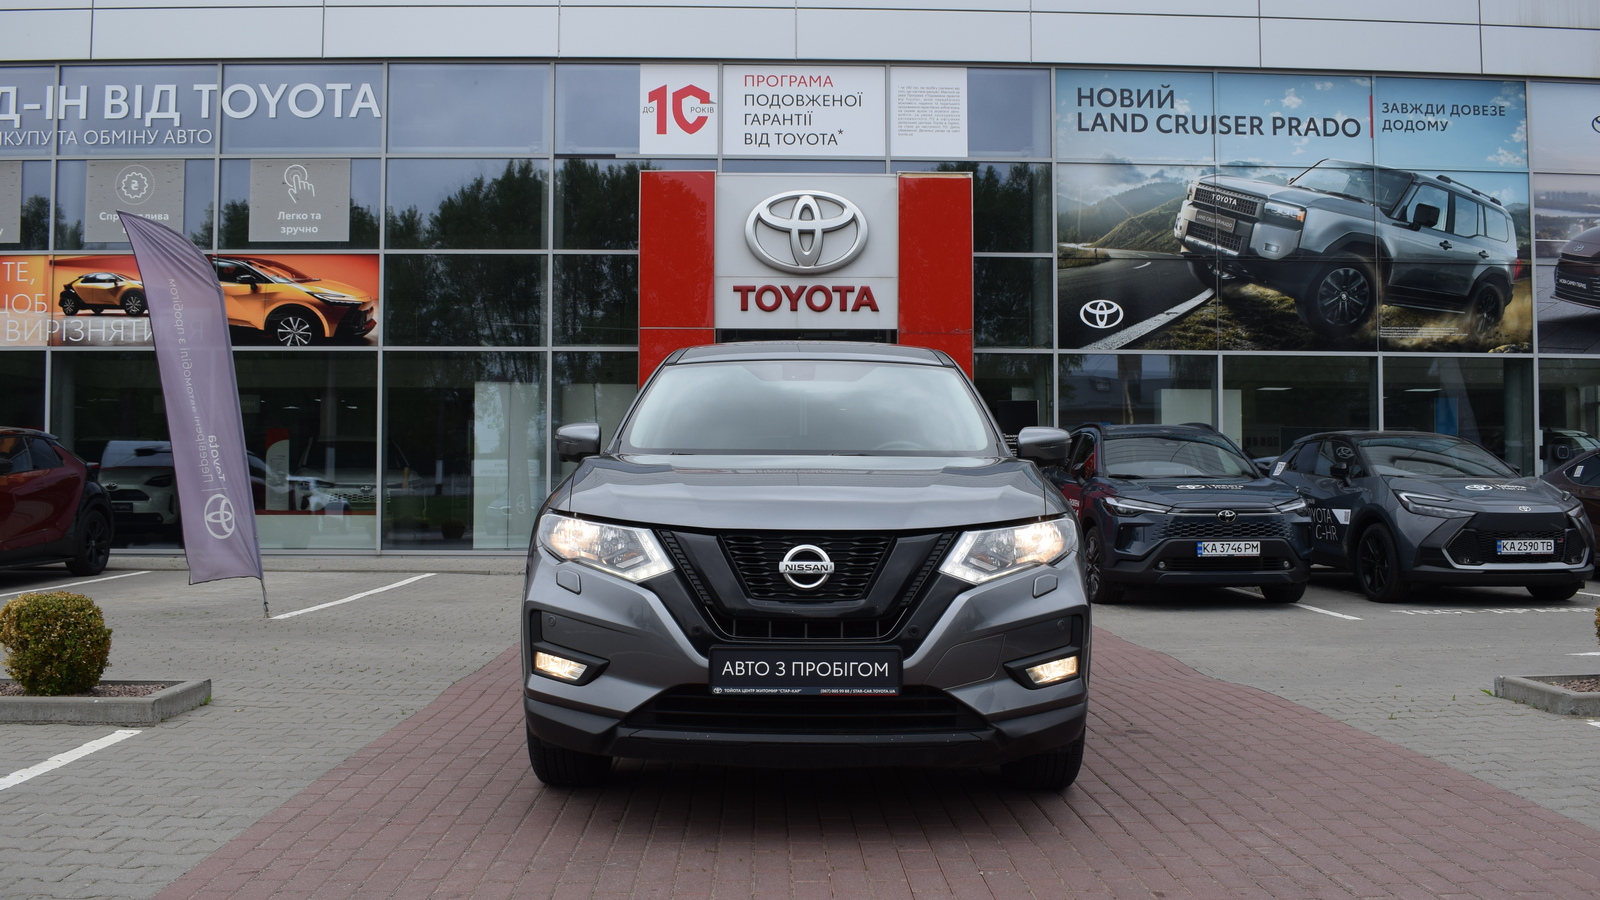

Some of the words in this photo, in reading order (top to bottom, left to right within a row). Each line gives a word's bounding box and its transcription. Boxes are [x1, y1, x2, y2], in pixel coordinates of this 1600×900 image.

[744, 75, 834, 87] ПРОГРАМА
[744, 92, 863, 109] ПОДОВЖЕНОЇ
[1077, 84, 1175, 109] НОВИЙ
[104, 84, 181, 127] ВІД
[193, 83, 382, 119] TOYOTA
[642, 106, 655, 114] ДО
[1381, 102, 1446, 116] ЗАВЖДИ
[1450, 104, 1507, 118] ДОВЕЗЕ
[744, 111, 813, 126] ГАРАНТІЇ
[1077, 112, 1149, 133] LAND
[1155, 114, 1265, 135] CRUISER
[1272, 116, 1362, 138] PRADO
[1381, 119, 1449, 134] ДОДОМУ
[0, 130, 52, 146] КУПУ
[58, 130, 78, 145] ТА
[83, 129, 159, 145] ОБМІНУ
[163, 129, 213, 145] АВТО
[744, 133, 771, 147] ВІД
[1211, 193, 1237, 206] TOYOTA
[277, 211, 308, 220] Легко
[311, 212, 322, 220] та
[280, 226, 319, 235] зручно
[733, 284, 880, 312] TOYOTA
[1315, 524, 1338, 540] C-HR
[1203, 542, 1218, 553] KA
[1219, 542, 1243, 553] 3746
[1244, 542, 1259, 553] PM
[1502, 541, 1516, 552] KA
[1517, 541, 1539, 551] 2590
[1541, 542, 1553, 552] TB
[722, 661, 770, 676] АВТО
[792, 661, 889, 677] ПРОБІГОМ
